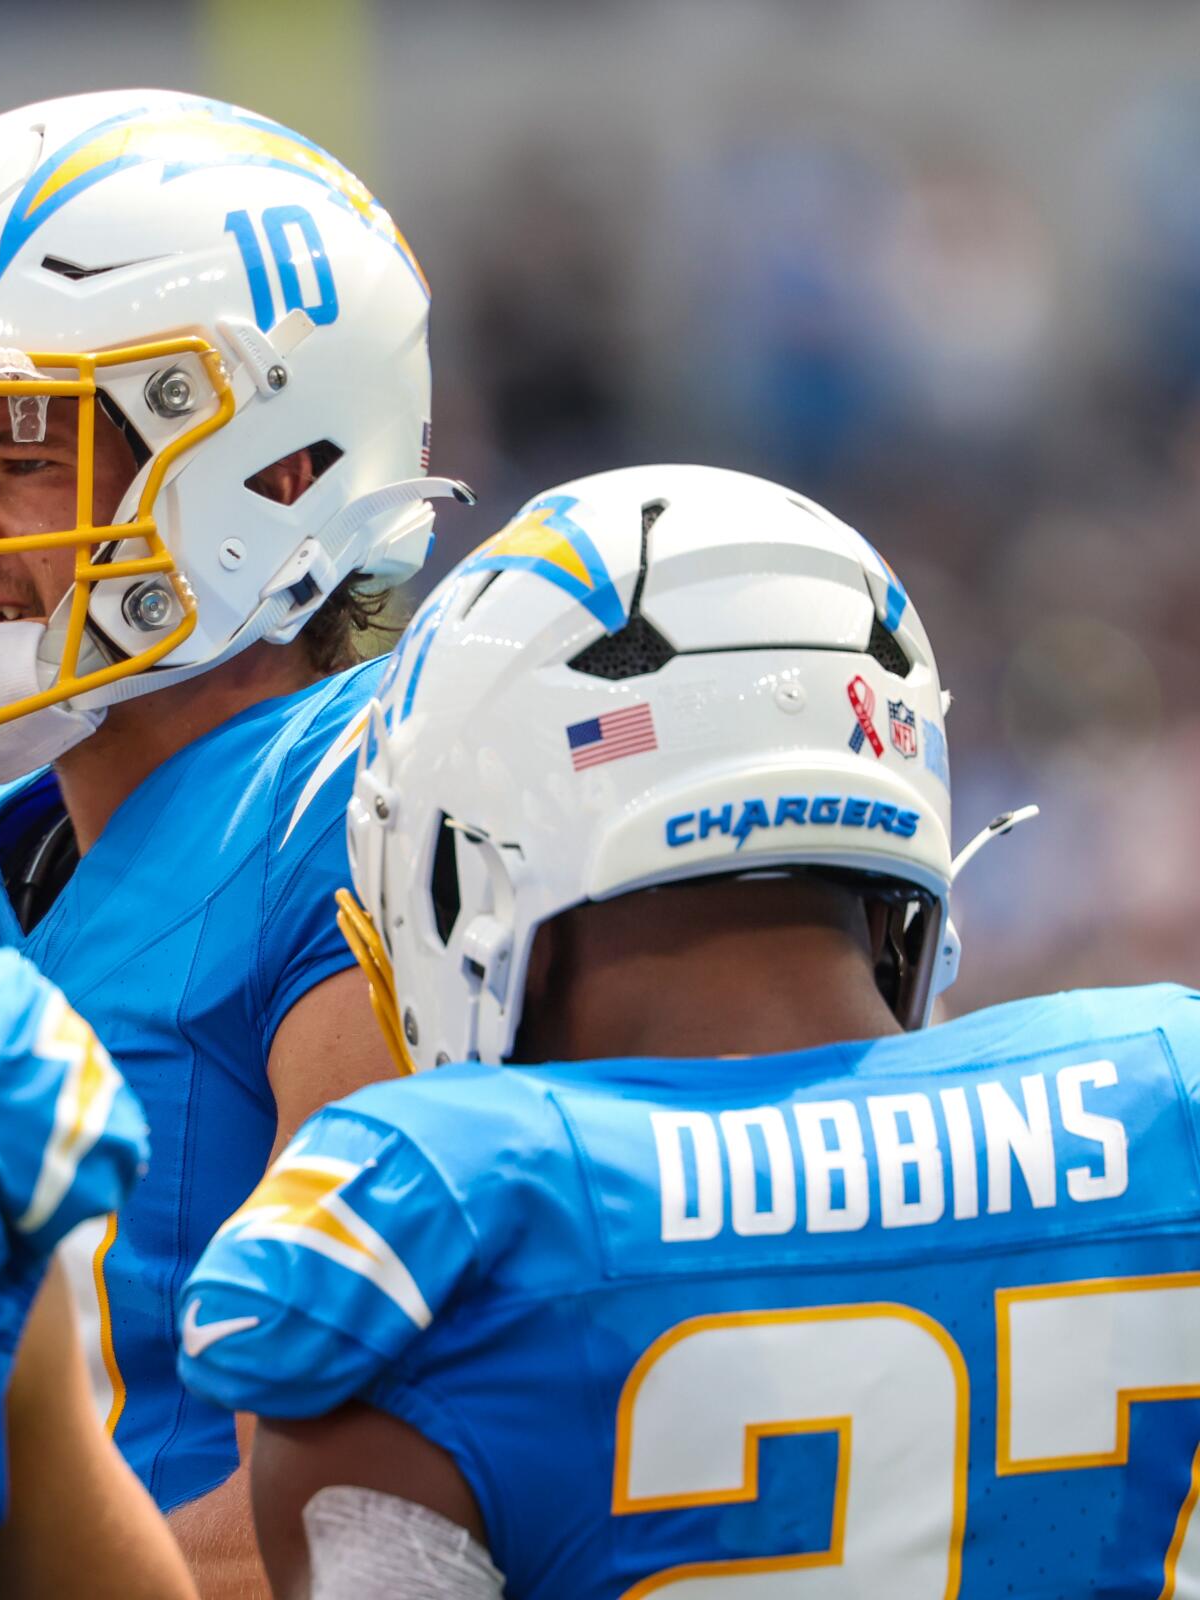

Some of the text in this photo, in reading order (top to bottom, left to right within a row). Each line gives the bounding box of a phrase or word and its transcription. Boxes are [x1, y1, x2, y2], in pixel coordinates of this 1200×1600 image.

[224, 205, 339, 334] 10
[666, 795, 920, 851] CHARGERS
[649, 1060, 1128, 1243] DOBBINS
